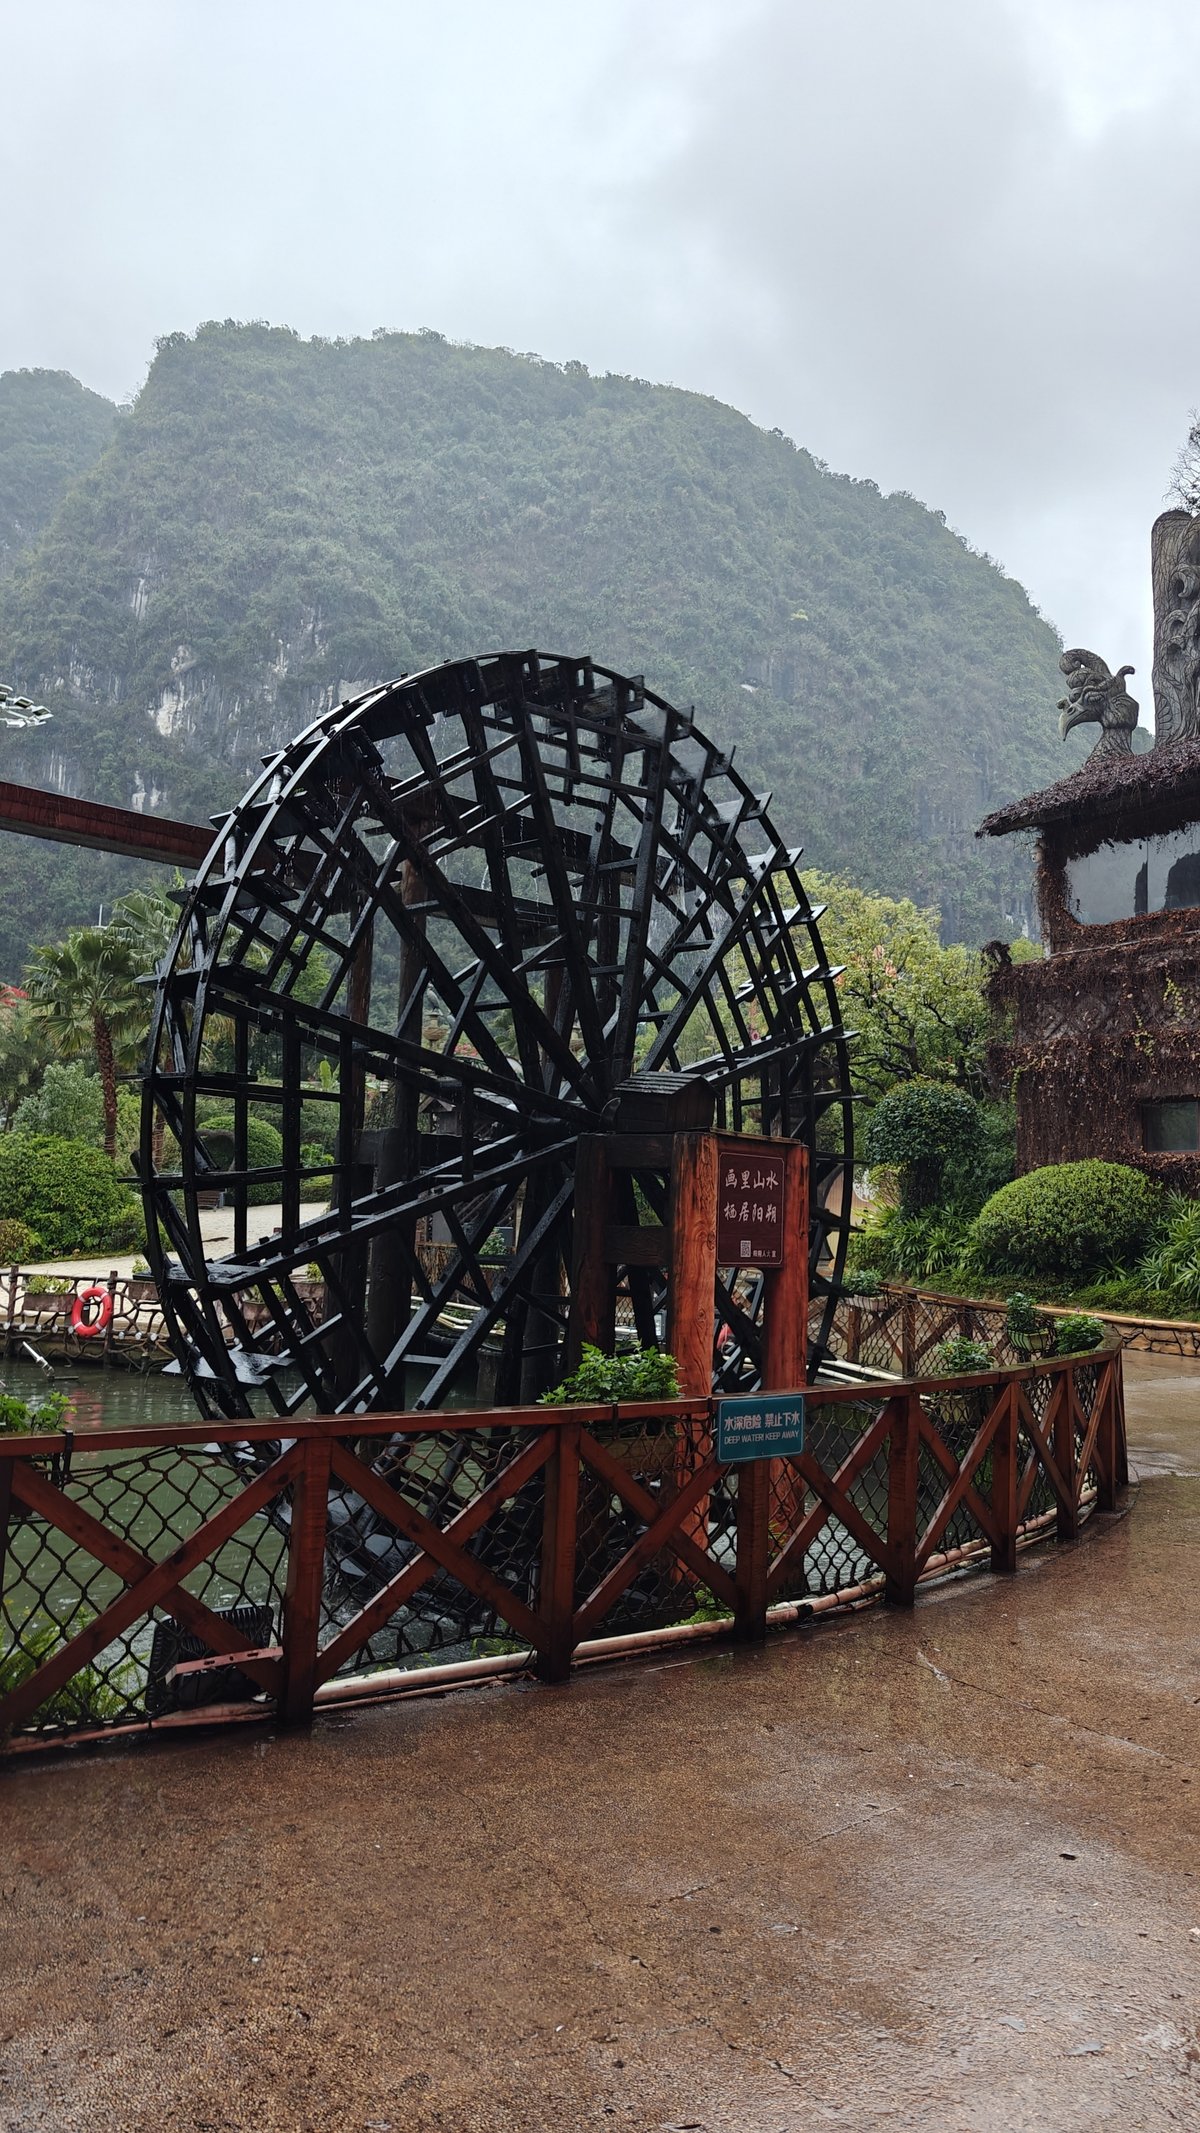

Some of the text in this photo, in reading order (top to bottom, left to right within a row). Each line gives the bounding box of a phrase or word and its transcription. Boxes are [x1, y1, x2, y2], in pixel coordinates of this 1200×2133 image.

[725, 1169, 779, 1190] 画里山水
[724, 1202, 777, 1223] 栖居阳朔
[724, 1412, 800, 1431] 水深危险 禁止下水
[724, 1436, 740, 1445] DEEP
[765, 1432, 781, 1440] KEEP
[782, 1431, 799, 1439] AWAY
